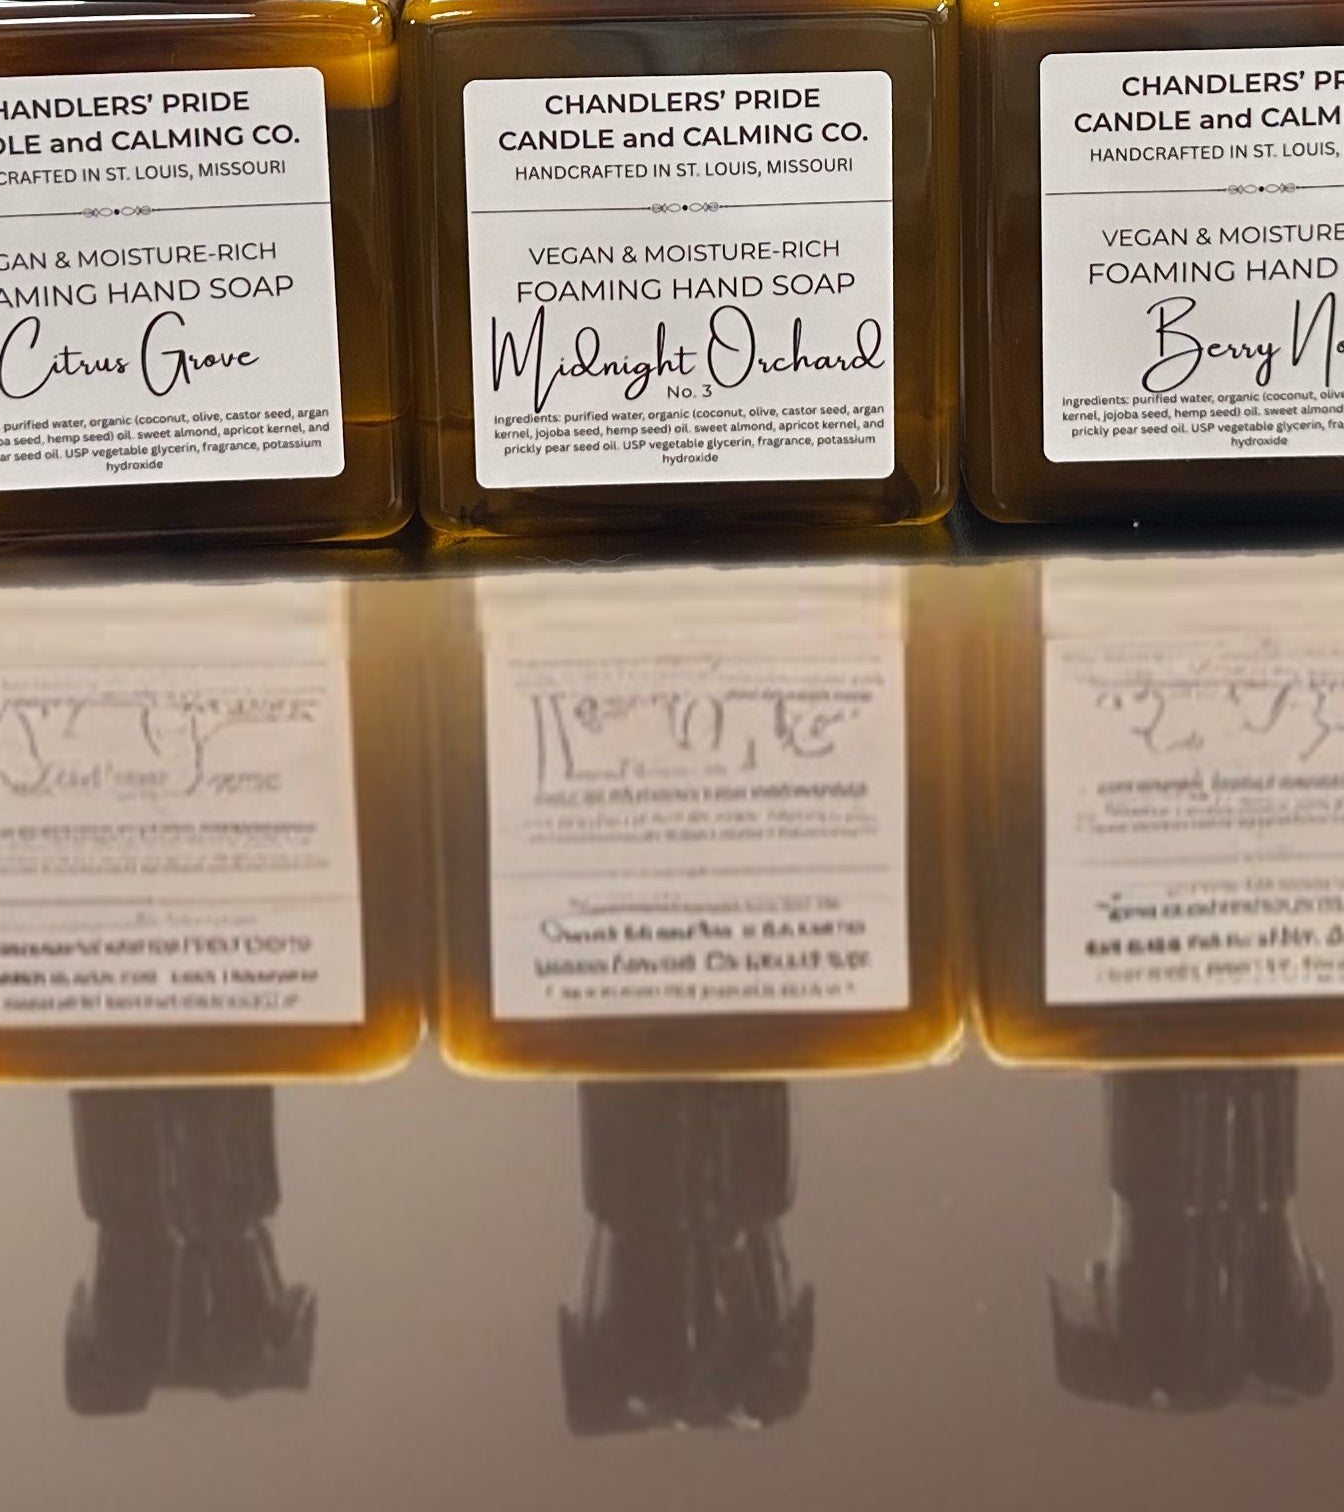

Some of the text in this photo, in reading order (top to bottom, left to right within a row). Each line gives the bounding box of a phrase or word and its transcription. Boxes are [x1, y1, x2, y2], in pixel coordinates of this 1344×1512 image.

[1121, 70, 1305, 98] CHANDLERS'
[162, 90, 251, 114] PRIDE
[544, 87, 821, 116] CHANDLERS' PRIDE
[1073, 109, 1192, 134] CANDLE
[1199, 106, 1253, 130] and
[49, 130, 103, 155] and
[110, 125, 245, 152] CALMING
[251, 123, 301, 146] CO.
[498, 121, 869, 152] CANDLE and CALMING CO.
[1101, 227, 1188, 248] VEGAN
[1195, 227, 1213, 246] &
[53, 250, 72, 270] &
[77, 241, 277, 269] MOISTURE-RICH
[528, 239, 840, 266] VEGAN & MOISTURE-RICH
[1089, 259, 1236, 286] FOAMING
[1246, 256, 1340, 282] HAND
[107, 278, 201, 305] HAND
[209, 274, 294, 300] SOAP
[517, 272, 856, 304] FOAMING HAND SOAP
[140, 310, 260, 398] Grove
[1141, 295, 1282, 395] Berry
[491, 304, 887, 416] Midnight Orchard
[666, 383, 713, 400] No. 3
[493, 403, 886, 428] Ingredients: purified water, organic (coconut, olive, castor seed, argan
[494, 416, 885, 441] kernel, jojoba seed, hemp seed) oil. sweet almond, apricot kernel, and
[503, 432, 876, 458] prickly pear seed oil. USP vegetable glycerin, fragrance, potassium
[661, 451, 721, 467] hydroxide
[105, 457, 166, 475] hydroxide
